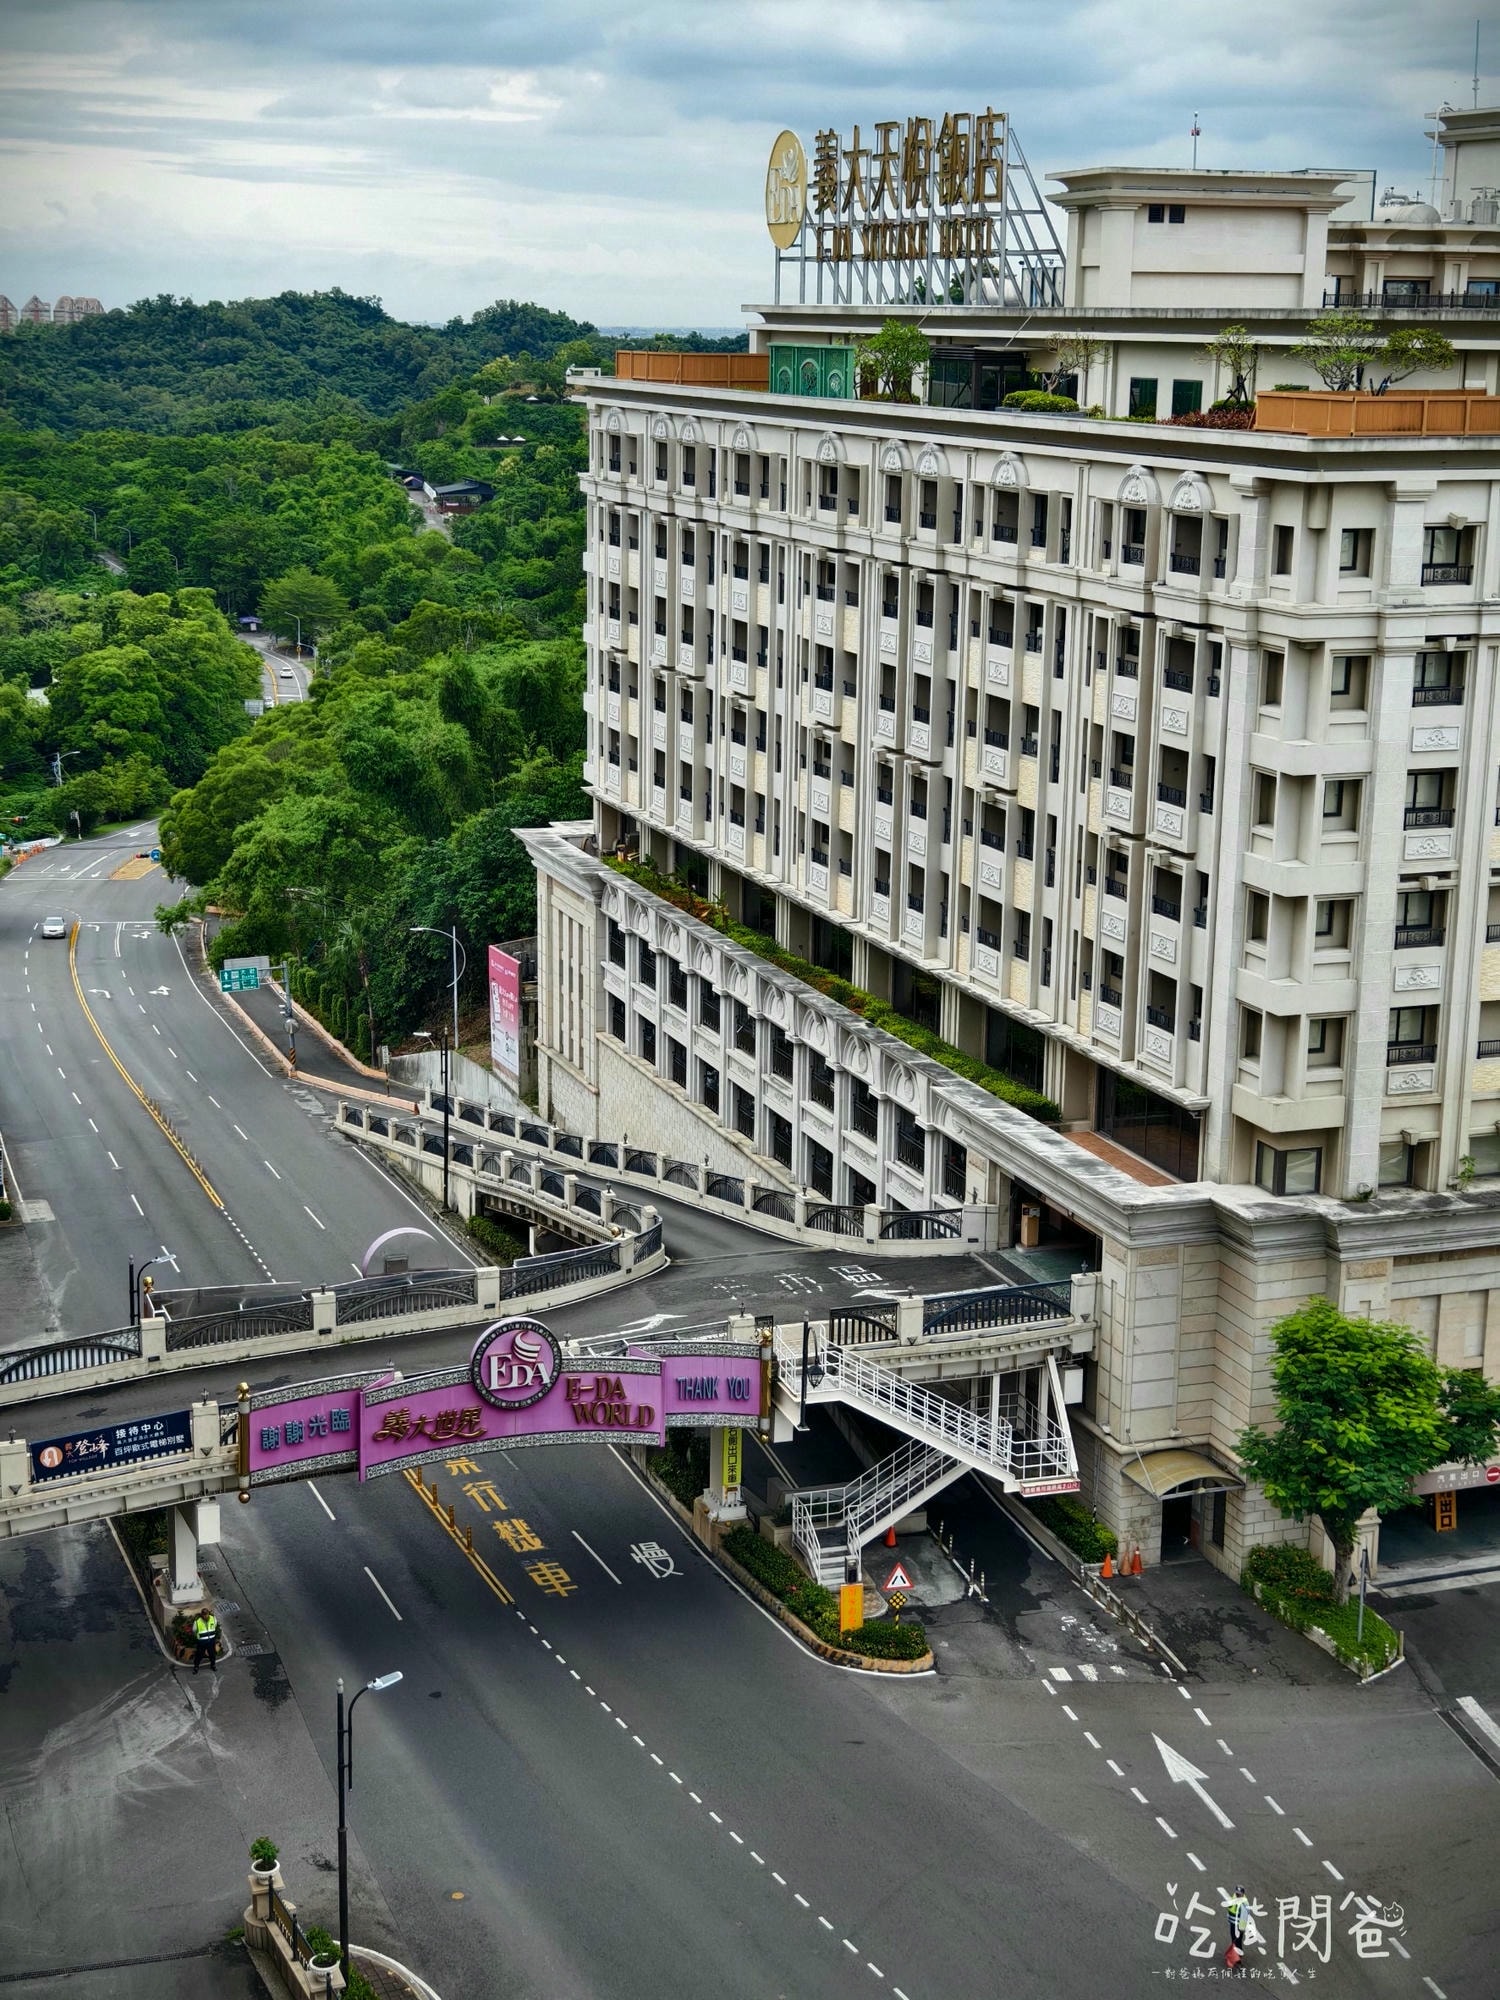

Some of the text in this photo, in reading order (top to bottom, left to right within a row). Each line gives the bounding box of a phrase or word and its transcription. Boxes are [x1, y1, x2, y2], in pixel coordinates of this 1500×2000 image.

[813, 106, 1004, 213] 義大天悅飯店
[487, 1353, 551, 1391] EDA
[675, 1375, 752, 1400] THANK YOU
[564, 1375, 627, 1401] E-DA
[115, 1421, 164, 1439] 接待中心
[260, 1407, 351, 1451] 謝謝光臨
[372, 1406, 487, 1442] 義大世界
[570, 1401, 655, 1428] WORLD
[1437, 1471, 1479, 1483] 汽車出口
[631, 1541, 684, 1579] 慢
